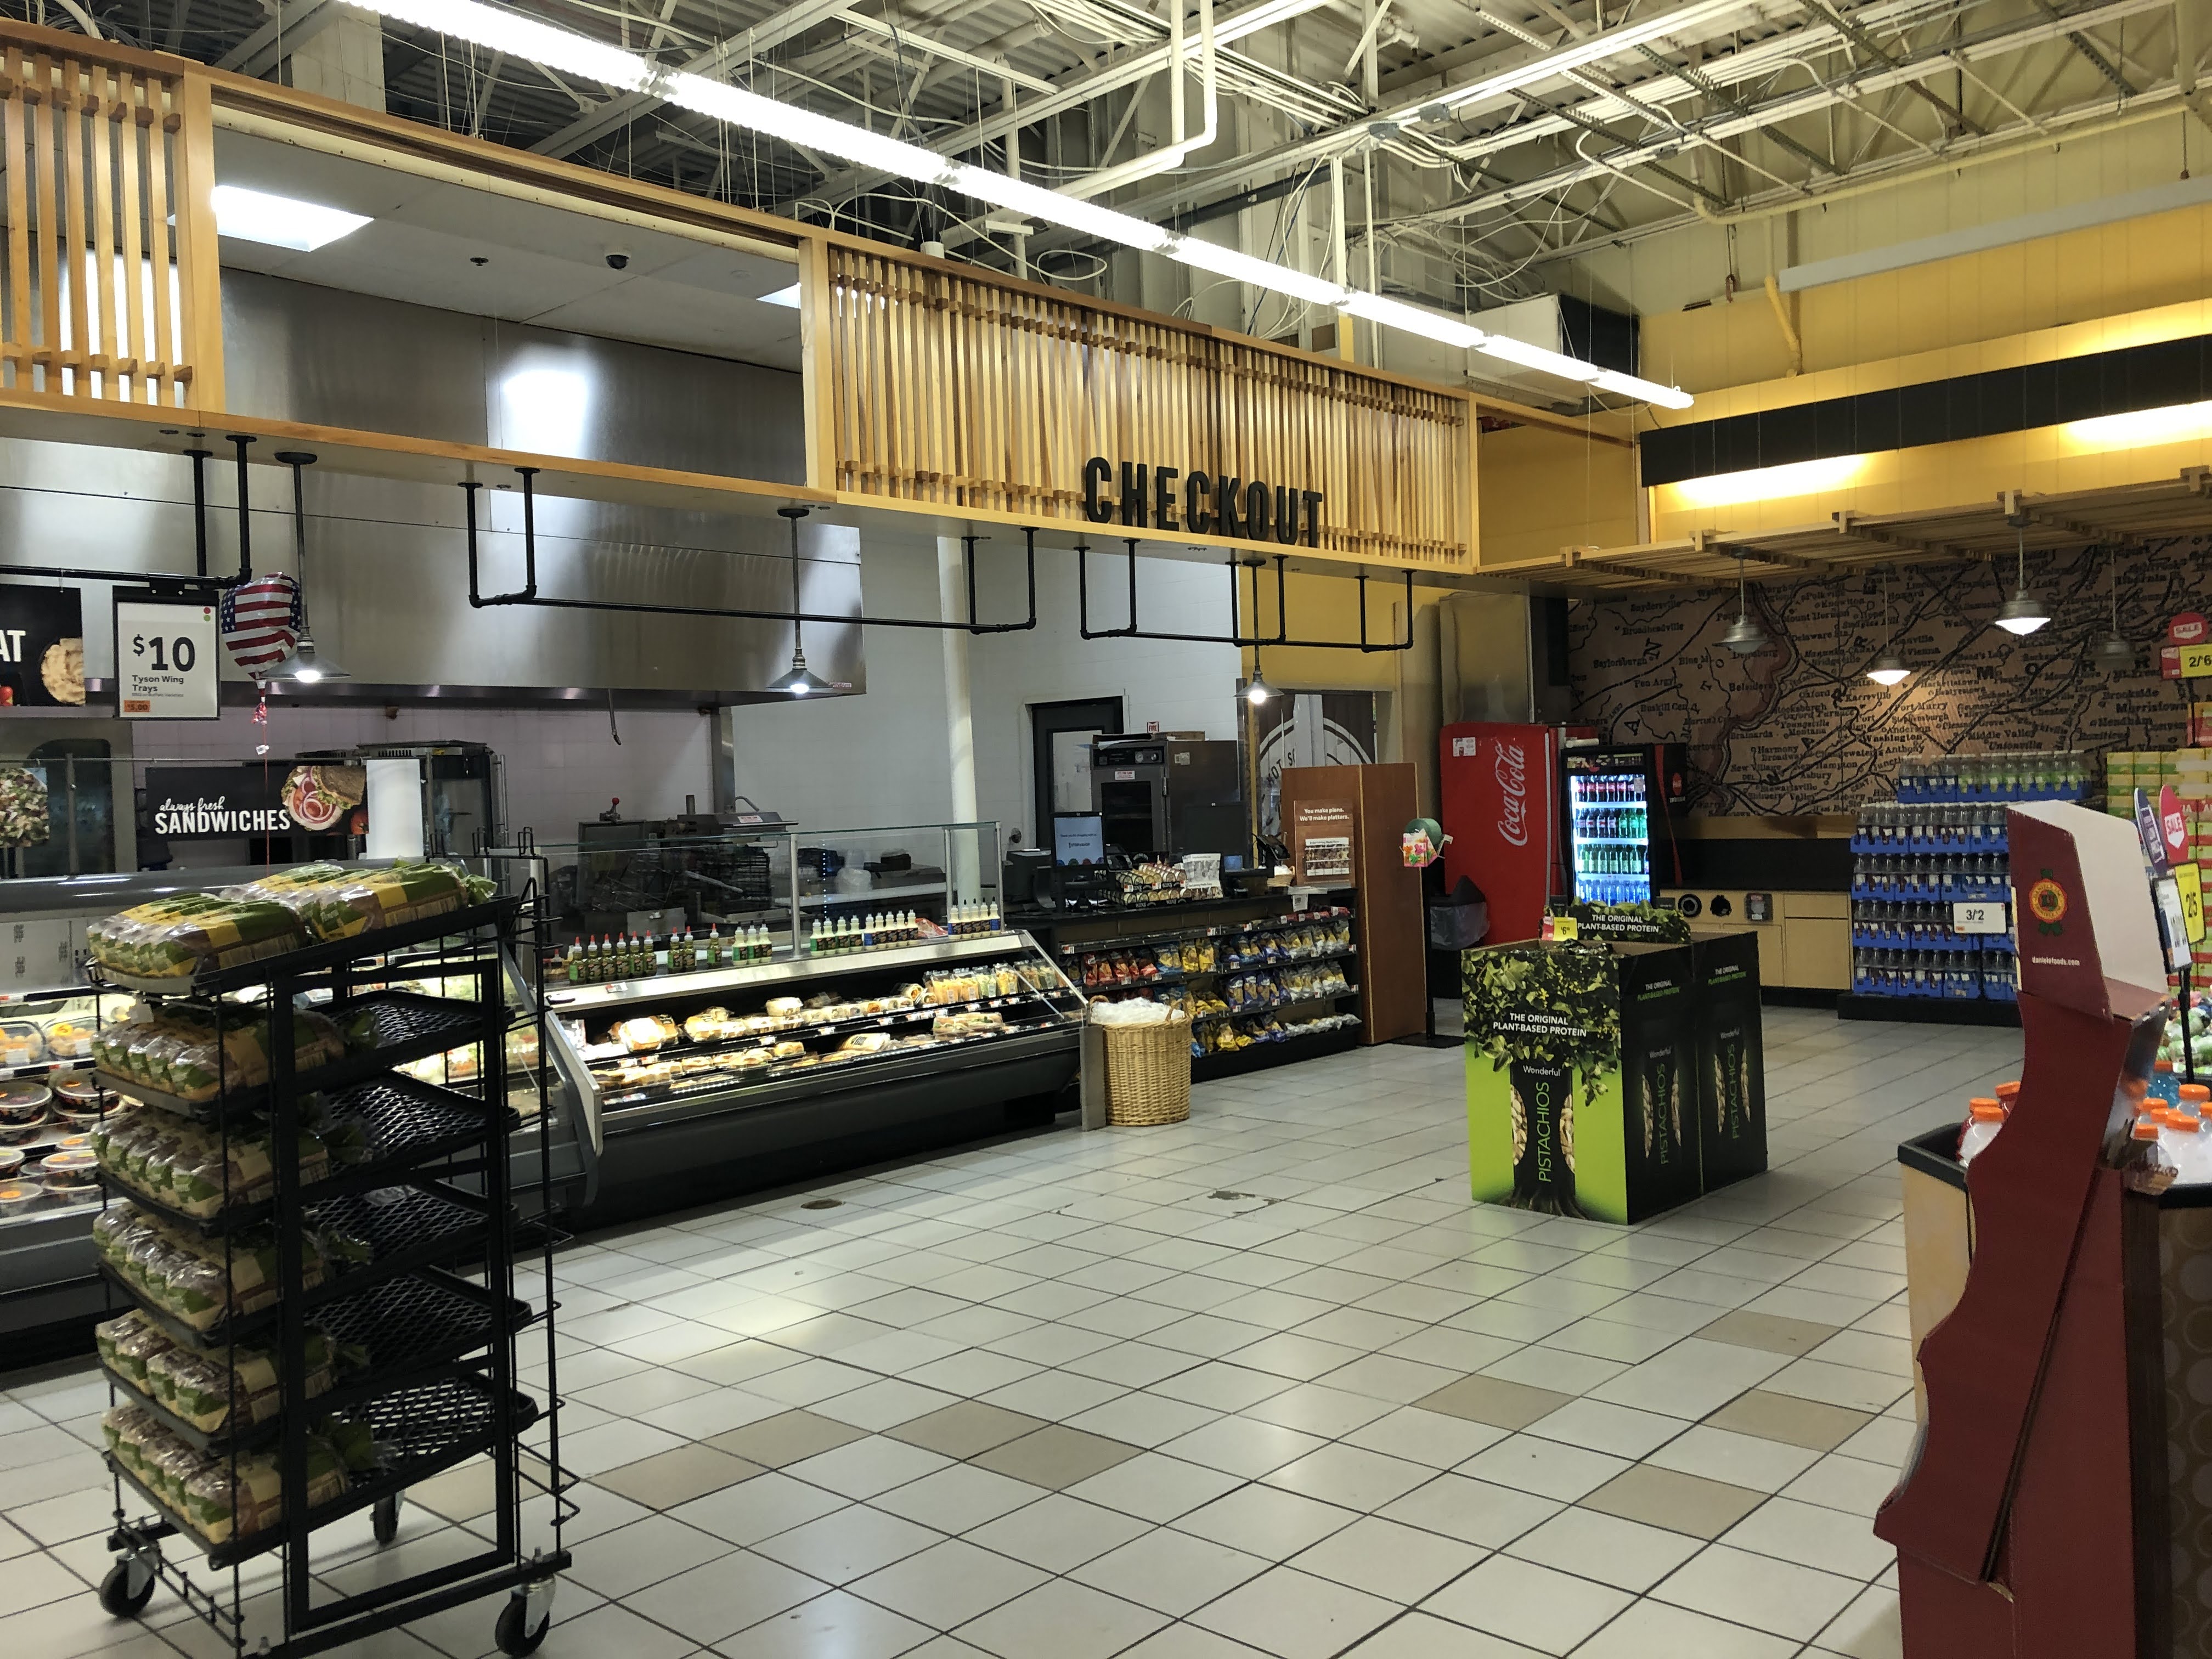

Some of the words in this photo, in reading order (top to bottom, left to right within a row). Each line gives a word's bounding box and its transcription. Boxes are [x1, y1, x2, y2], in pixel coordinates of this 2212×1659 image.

[1086, 457, 1322, 548] CHECKOUT
[133, 634, 195, 672] $10
[132, 675, 160, 684] Tyson
[162, 676, 184, 684] Wing
[132, 684, 158, 693] Trays
[1758, 745, 1799, 755] Harmony
[1494, 738, 1528, 846] Coca-Cola
[159, 798, 196, 812] always
[198, 796, 225, 811] fresh
[155, 809, 290, 834] SANDWICHES
[2166, 816, 2182, 835] SALE
[1608, 915, 1643, 923] ORIGINAL
[1577, 922, 1625, 932] PLANT-BASED
[1627, 924, 1660, 933] PROTEIN
[1510, 1013, 1526, 1023] THE
[1528, 1014, 1568, 1025] ORIGINAL
[1493, 1022, 1547, 1034] PLANT-BASED
[1550, 1026, 1587, 1037] PROTEIN
[1523, 1065, 1560, 1077] Wonderful
[1726, 1043, 1739, 1139] PISTACHIOS
[1657, 1062, 1669, 1165] PISTACHIOS
[1536, 1081, 1551, 1182] PISTACHIOS
